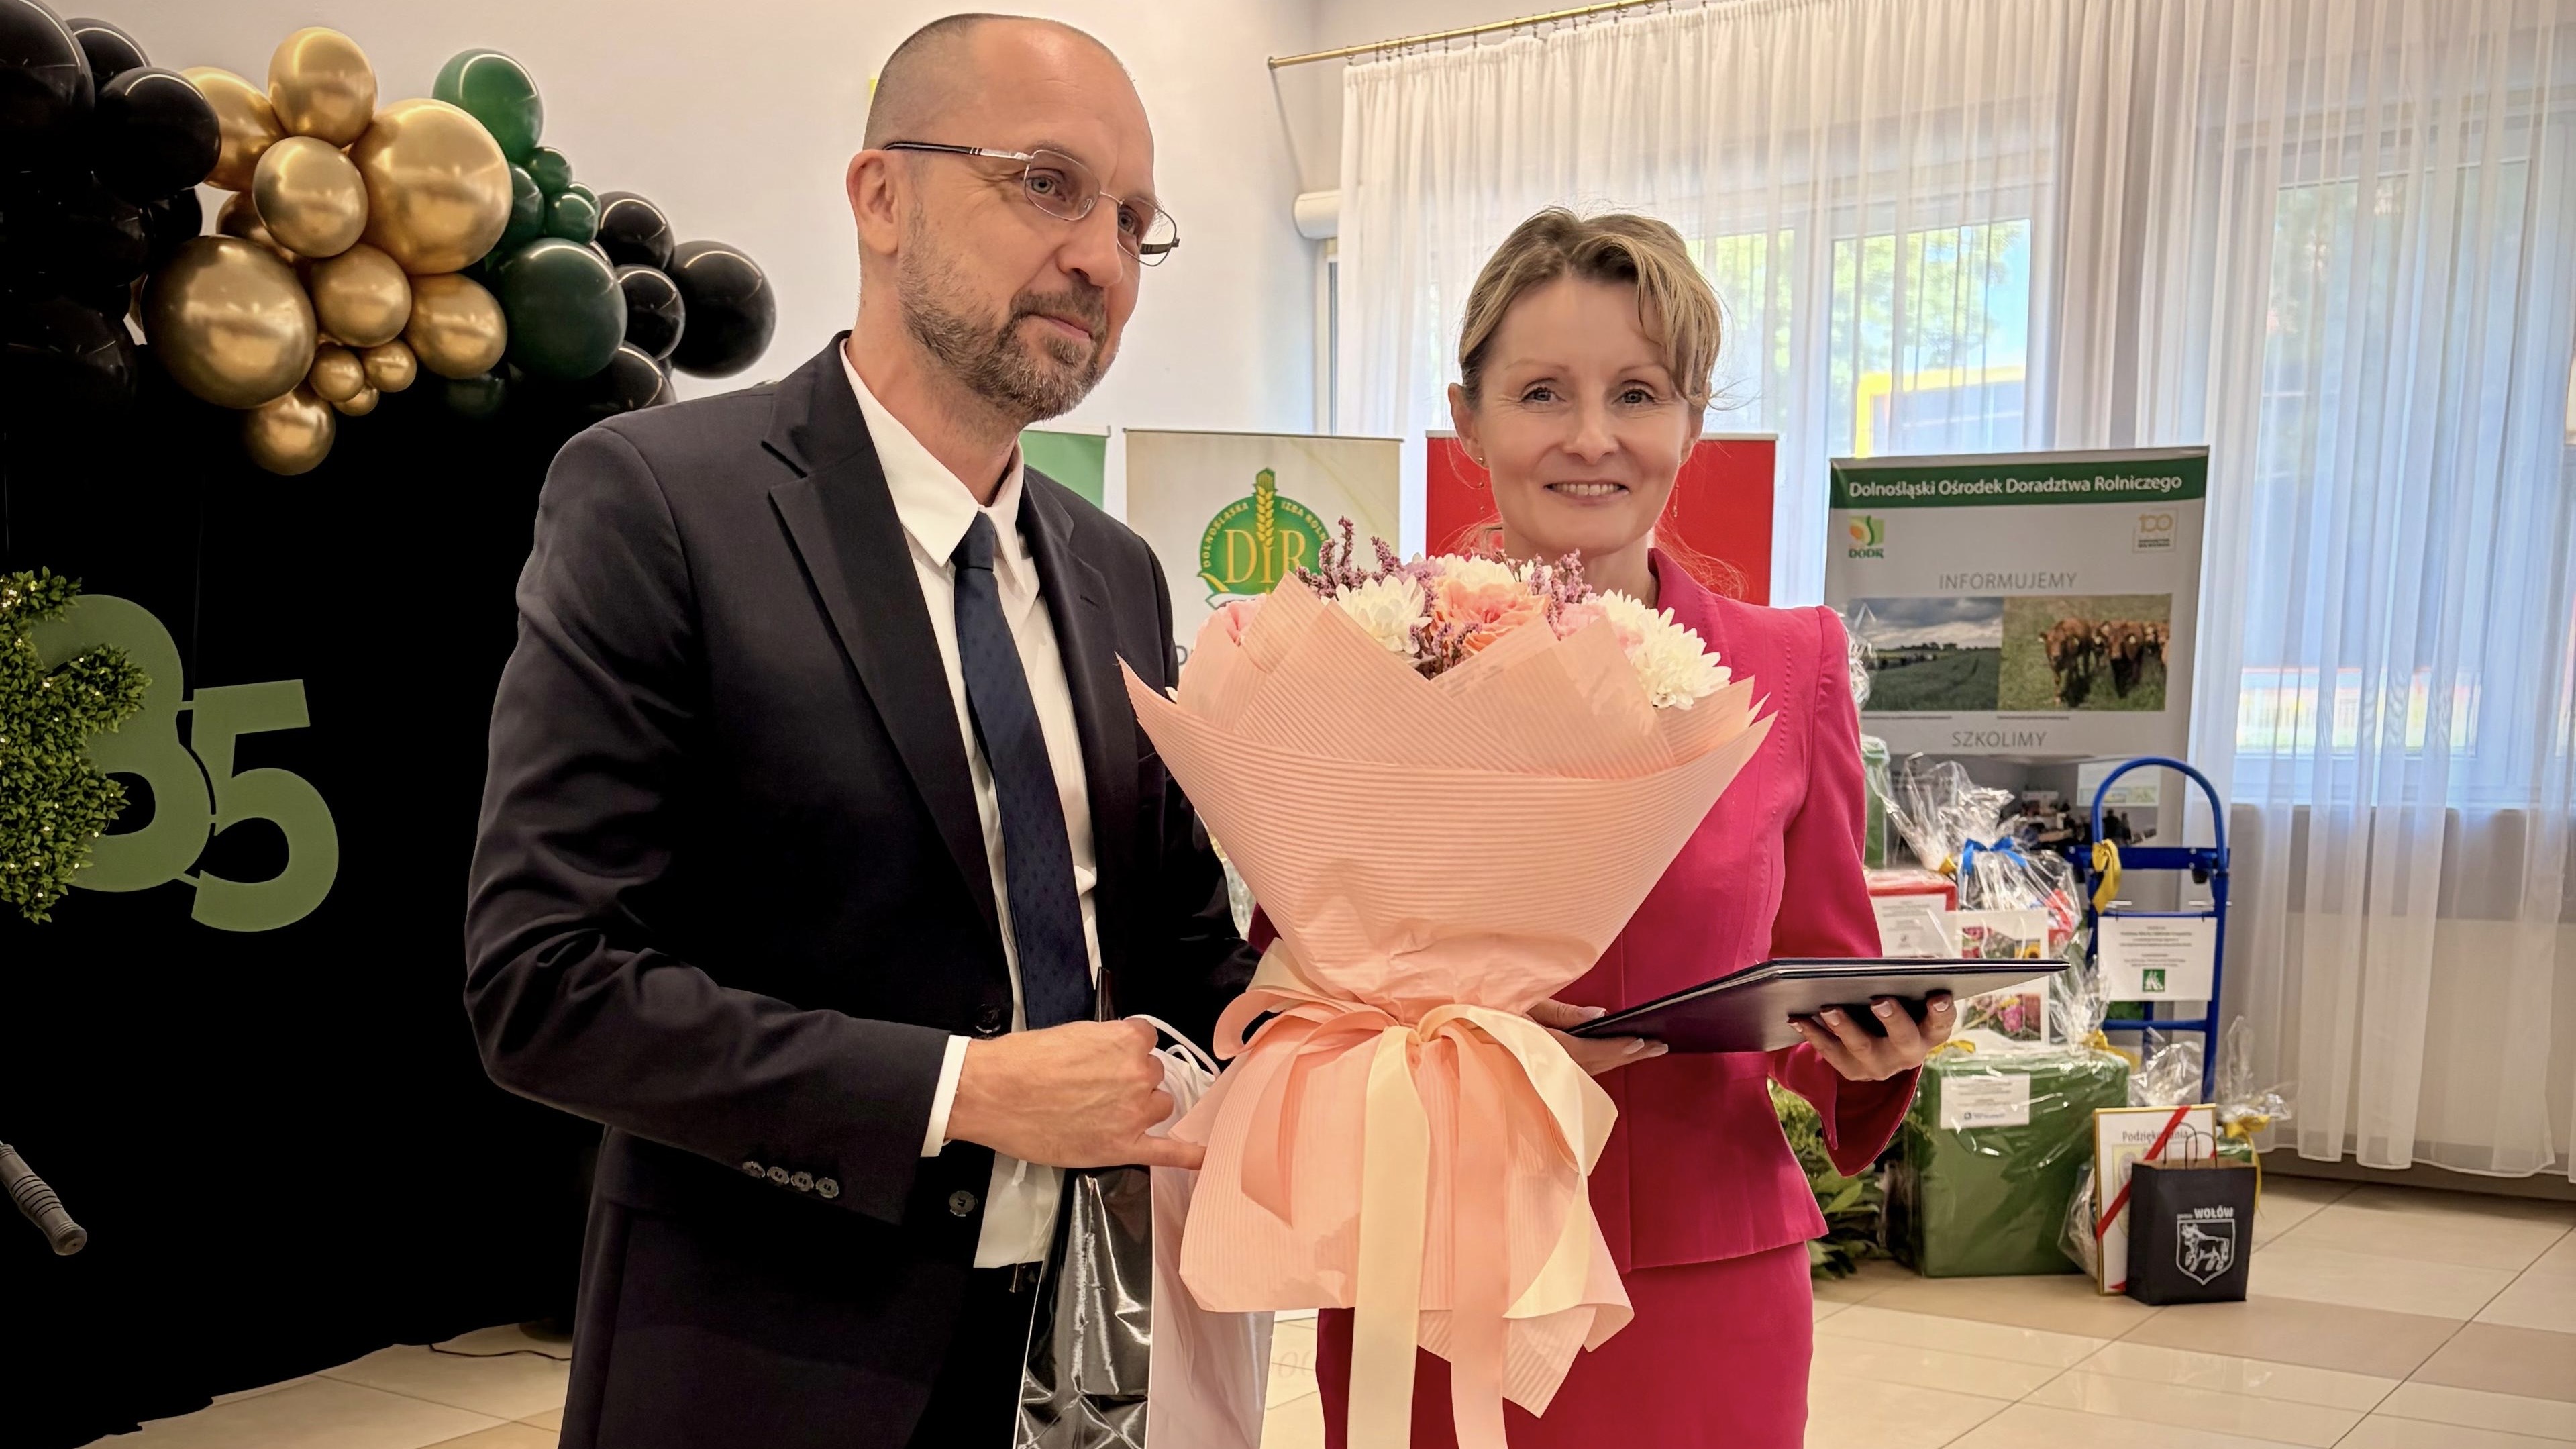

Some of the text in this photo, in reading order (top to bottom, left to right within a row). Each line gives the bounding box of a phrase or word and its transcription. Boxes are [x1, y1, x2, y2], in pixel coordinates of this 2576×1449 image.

[1849, 474, 2182, 499] Dolnośląski Ośrodek Doradztwa Rolniczego
[1280, 501, 1304, 517] IZBA
[1939, 572, 2077, 589] INFORMUJEMY
[1951, 731, 2047, 747] SZKOLIMY
